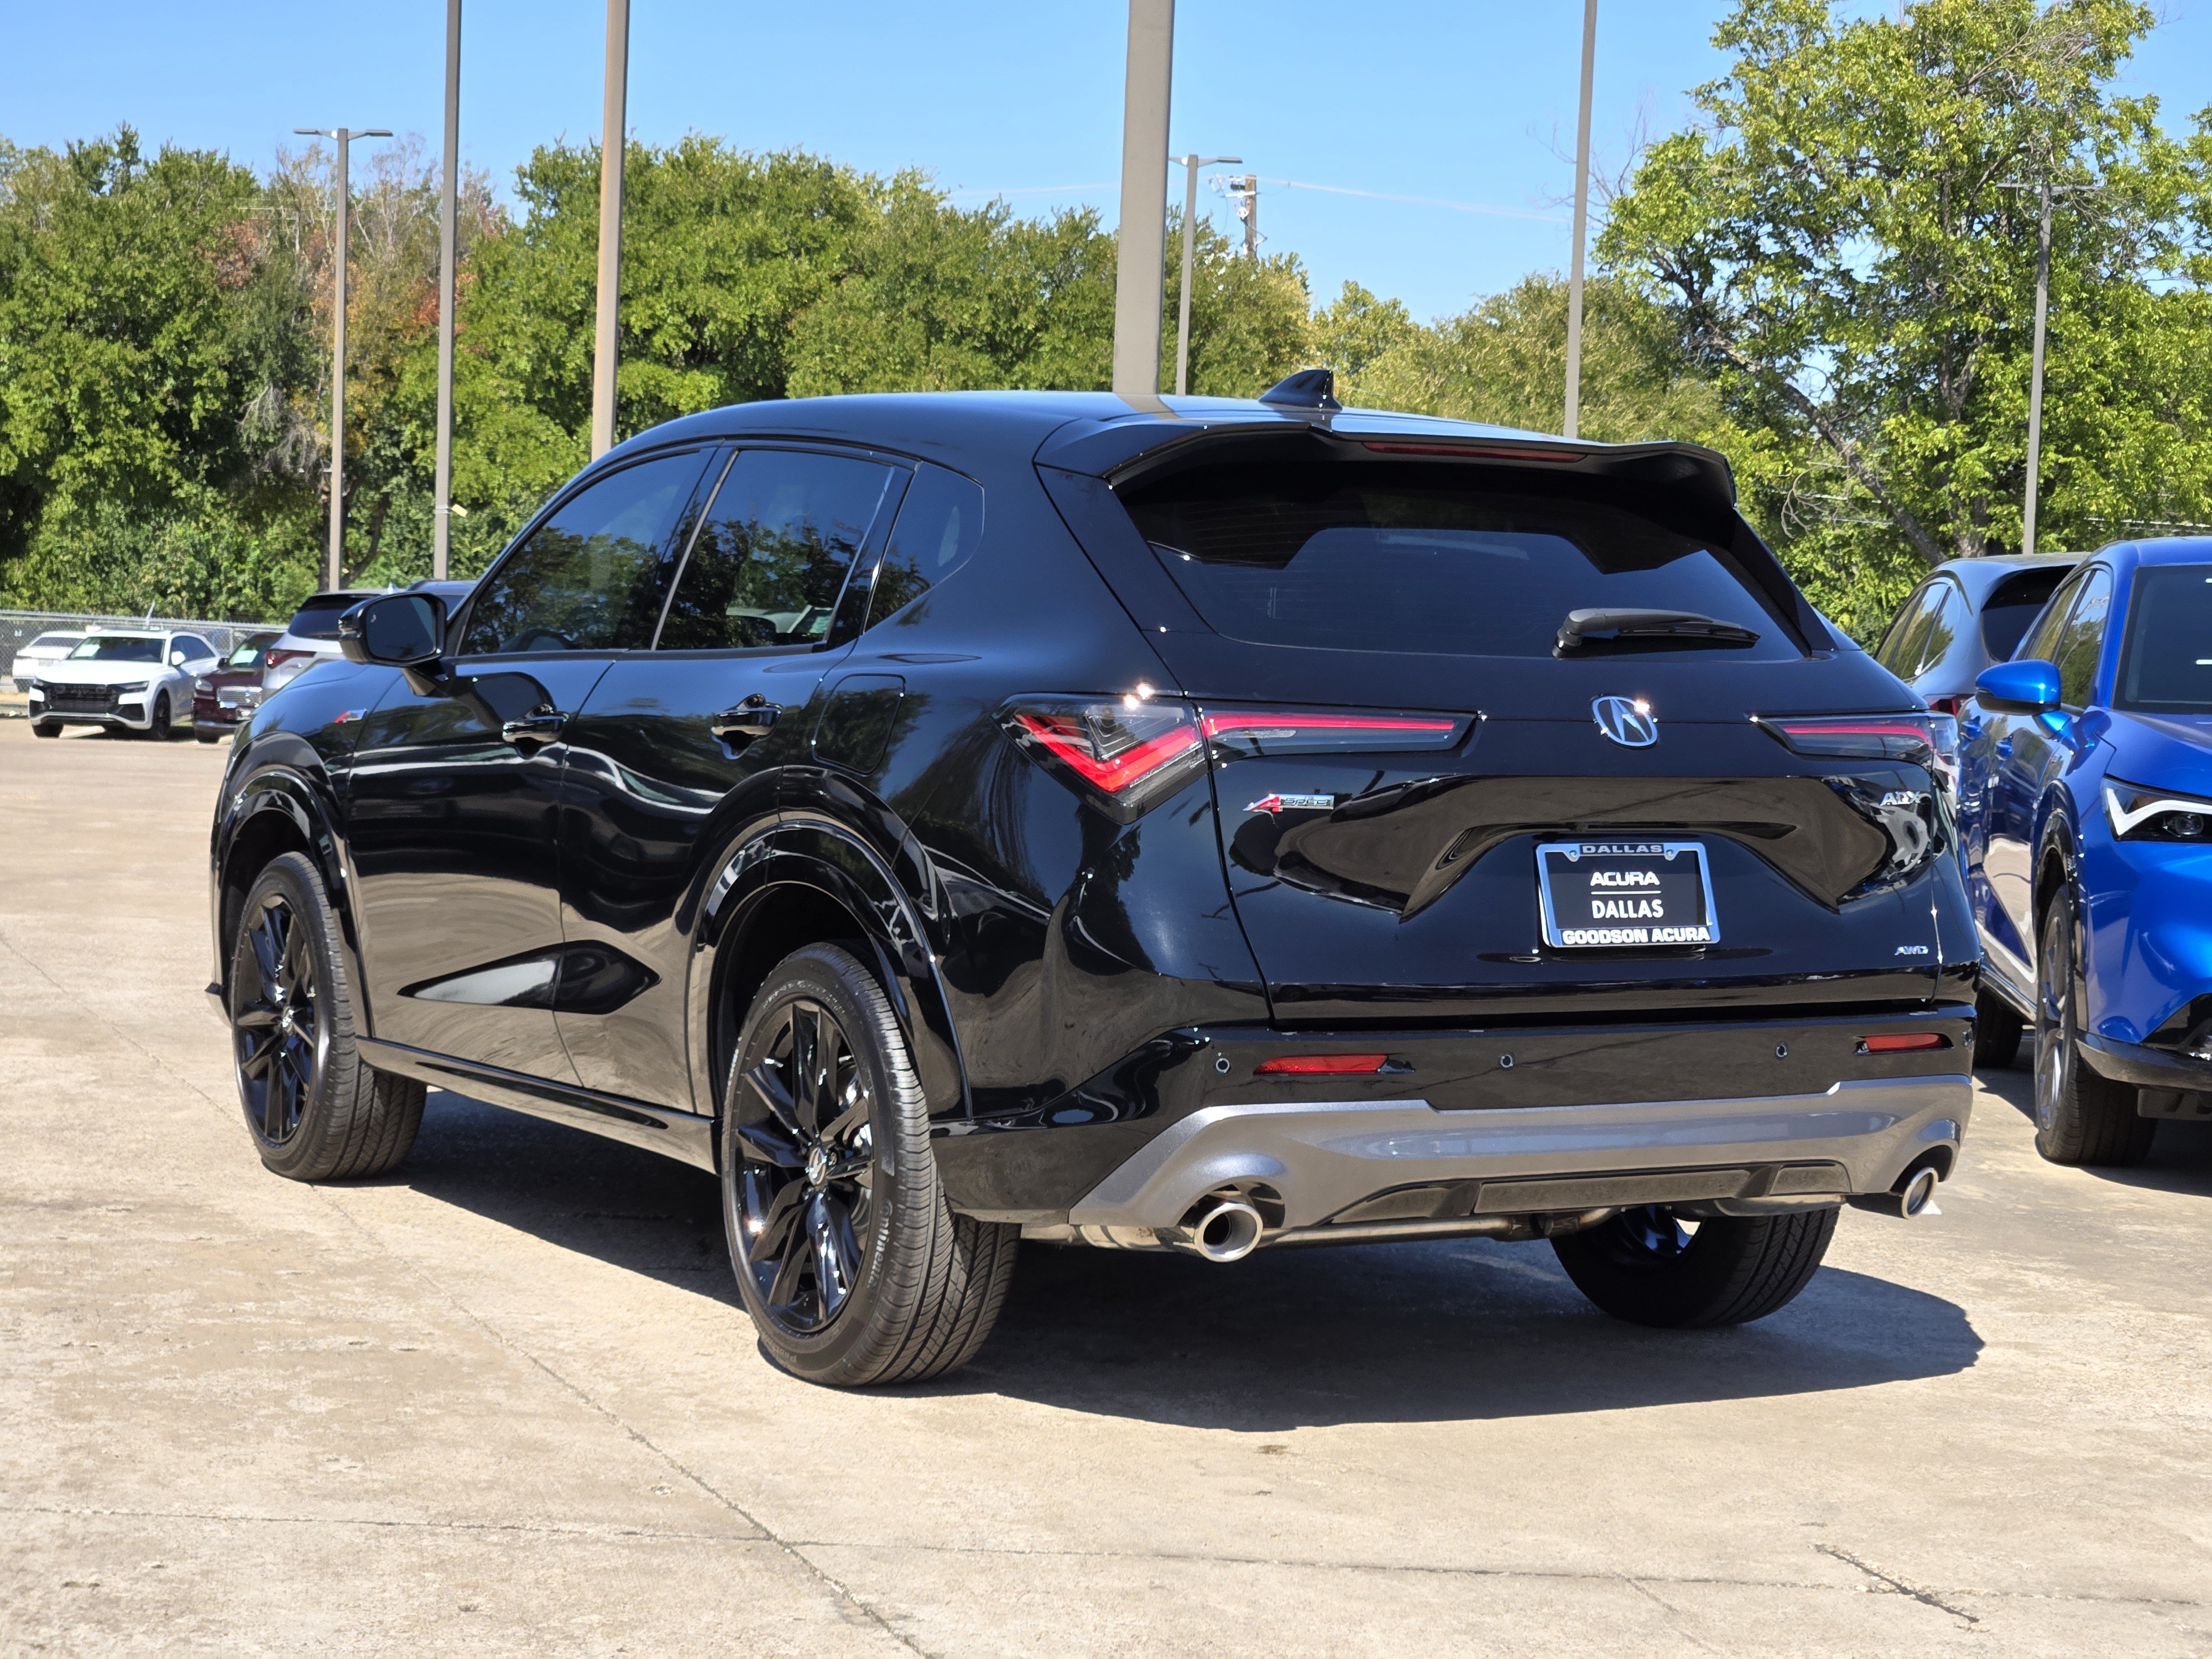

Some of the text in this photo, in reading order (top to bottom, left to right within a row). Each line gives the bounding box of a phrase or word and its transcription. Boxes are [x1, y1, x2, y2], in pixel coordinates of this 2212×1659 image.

[1582, 844, 1662, 854] DALLAS
[1590, 871, 1660, 886] ACURA
[1592, 899, 1664, 919] DALLAS
[1562, 927, 1710, 945] GOODSON ACURA
[1894, 945, 1929, 956] AWD
